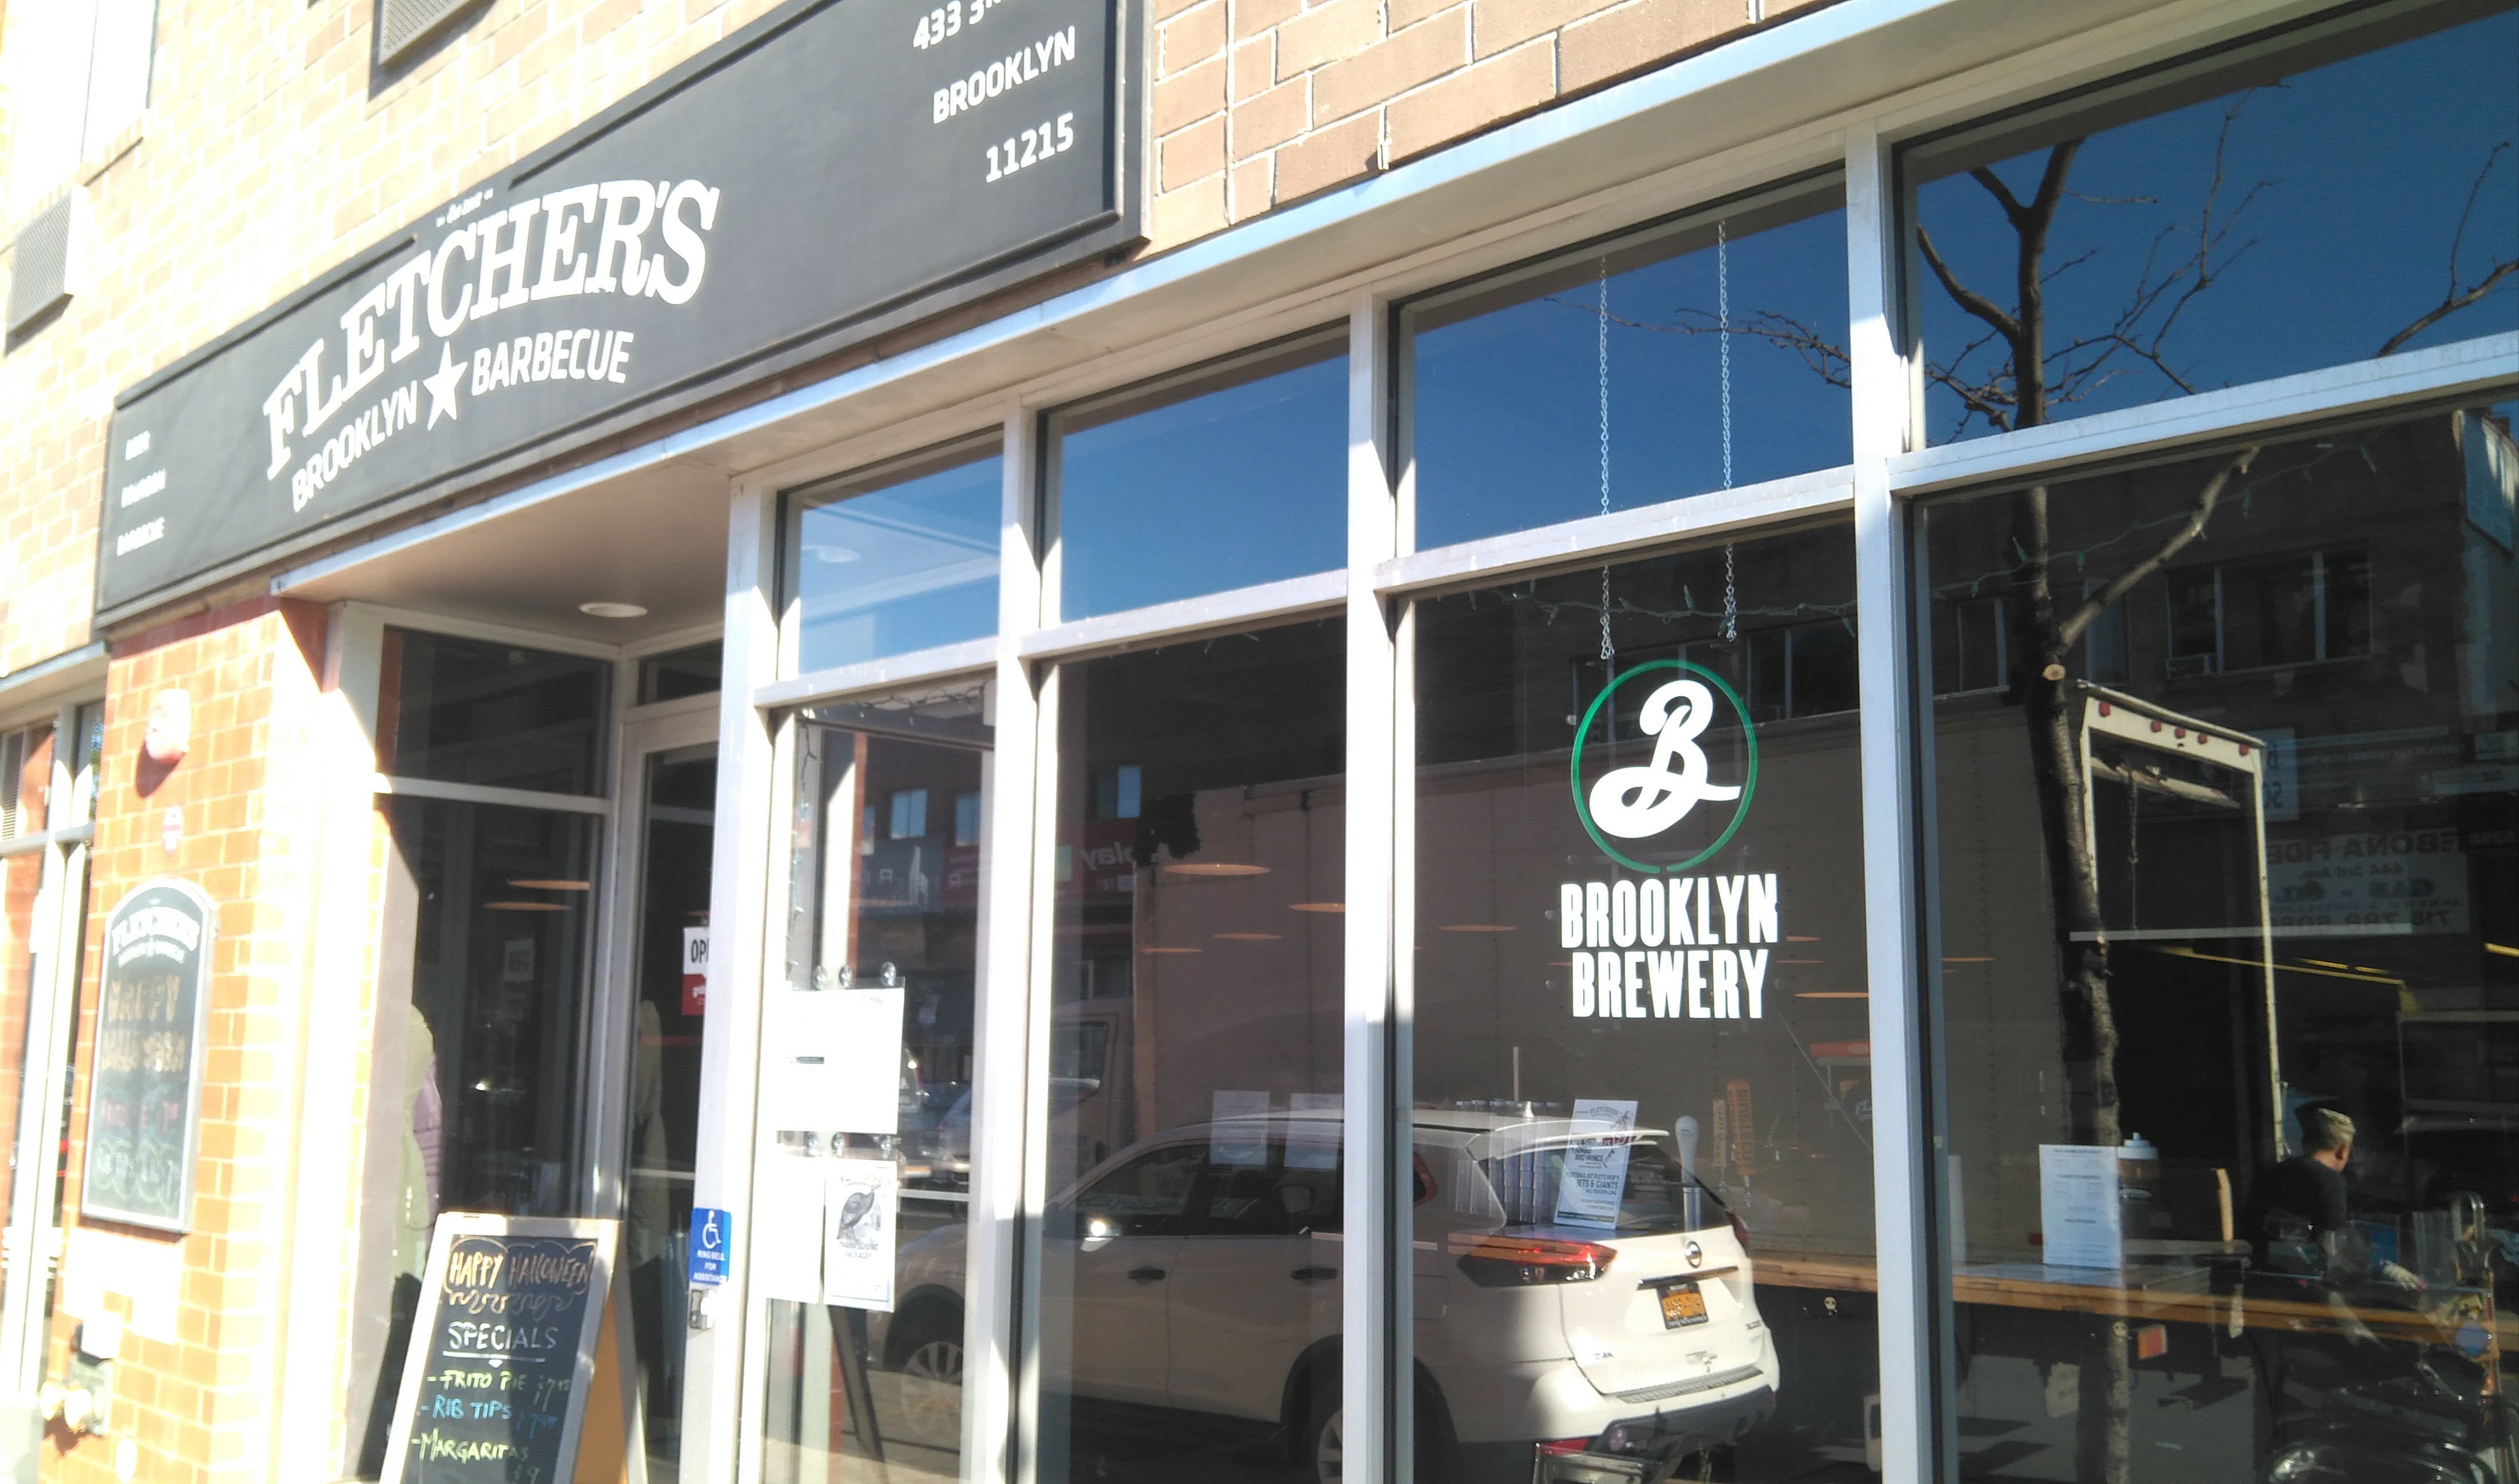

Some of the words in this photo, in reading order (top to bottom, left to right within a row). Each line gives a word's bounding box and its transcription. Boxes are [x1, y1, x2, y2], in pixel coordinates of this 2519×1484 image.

[913, 0, 961, 50] 433
[933, 25, 1076, 124] BROOKLYN
[986, 112, 1074, 183] 11215
[263, 179, 720, 482] FLETCHER'S
[293, 380, 419, 513] BROOKLYN
[471, 329, 634, 397] BARBECUE
[1560, 873, 1778, 948] BROOKLYN
[1572, 949, 1768, 1019] BREWERY
[1576, 1179, 1590, 1187] JETS
[1596, 1181, 1619, 1190] GIANTS
[450, 1251, 503, 1288] HAPPY
[508, 1252, 591, 1288] HALLOWEEN
[448, 1321, 559, 1350] SPECIALS
[470, 1400, 513, 1420] TIPS
[500, 1371, 527, 1391] PIE
